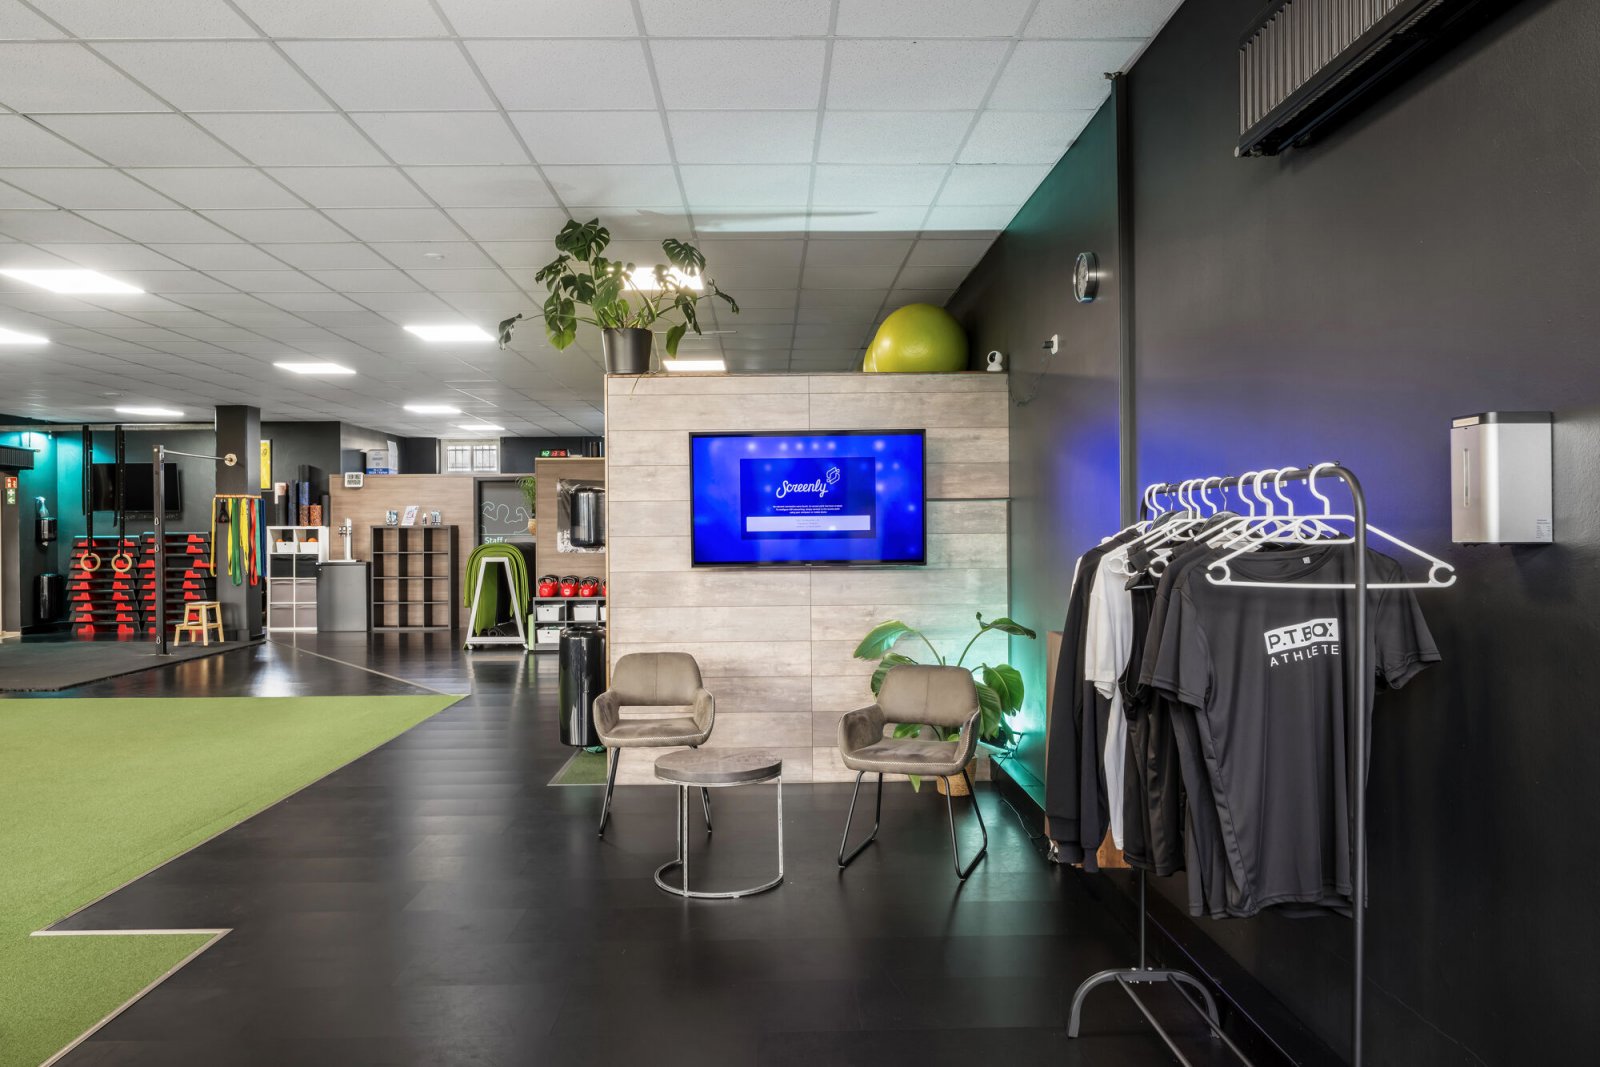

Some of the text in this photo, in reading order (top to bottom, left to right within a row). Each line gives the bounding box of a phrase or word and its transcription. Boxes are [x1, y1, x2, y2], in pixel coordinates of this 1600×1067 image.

[776, 479, 828, 498] Screenly
[485, 536, 503, 544] Staff
[1270, 644, 1339, 668] ATHLETE
